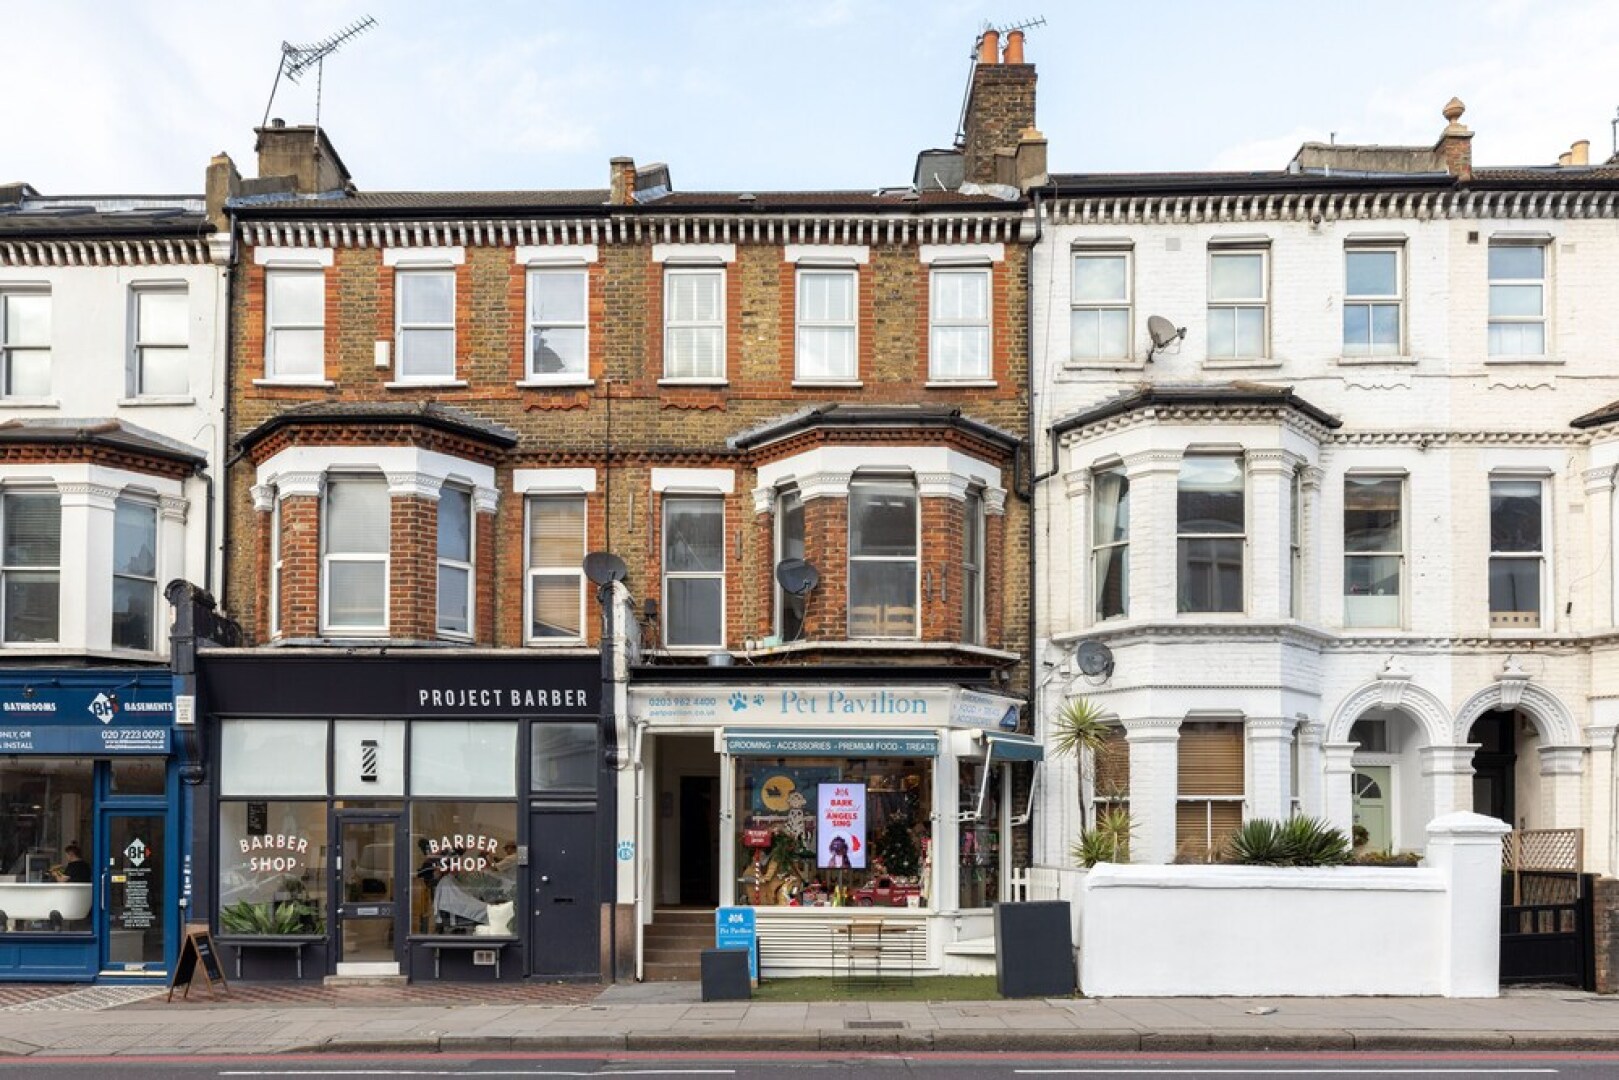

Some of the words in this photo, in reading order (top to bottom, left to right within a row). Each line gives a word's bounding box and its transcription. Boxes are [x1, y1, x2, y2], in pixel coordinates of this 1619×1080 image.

[418, 689, 502, 707] PROJECT
[510, 689, 588, 707] BARBER
[780, 689, 816, 714] Pet
[827, 689, 927, 714] Pavilion
[3, 702, 56, 712] BATHROOMS
[124, 702, 173, 712] BASEMENTS
[101, 730, 119, 740] 020
[120, 730, 141, 740] 7223
[142, 730, 166, 740] 0093
[728, 741, 771, 750] GROOMING
[776, 741, 831, 750] ACCESSORIES
[838, 742, 874, 750] PREMIUM
[876, 742, 898, 750] FOOD
[906, 742, 935, 751] TREATS
[826, 812, 858, 820] ANGELS
[239, 833, 309, 854] BARBER
[428, 833, 499, 854] BARBER
[250, 857, 297, 872] SHOP
[440, 857, 487, 872] SHOP
